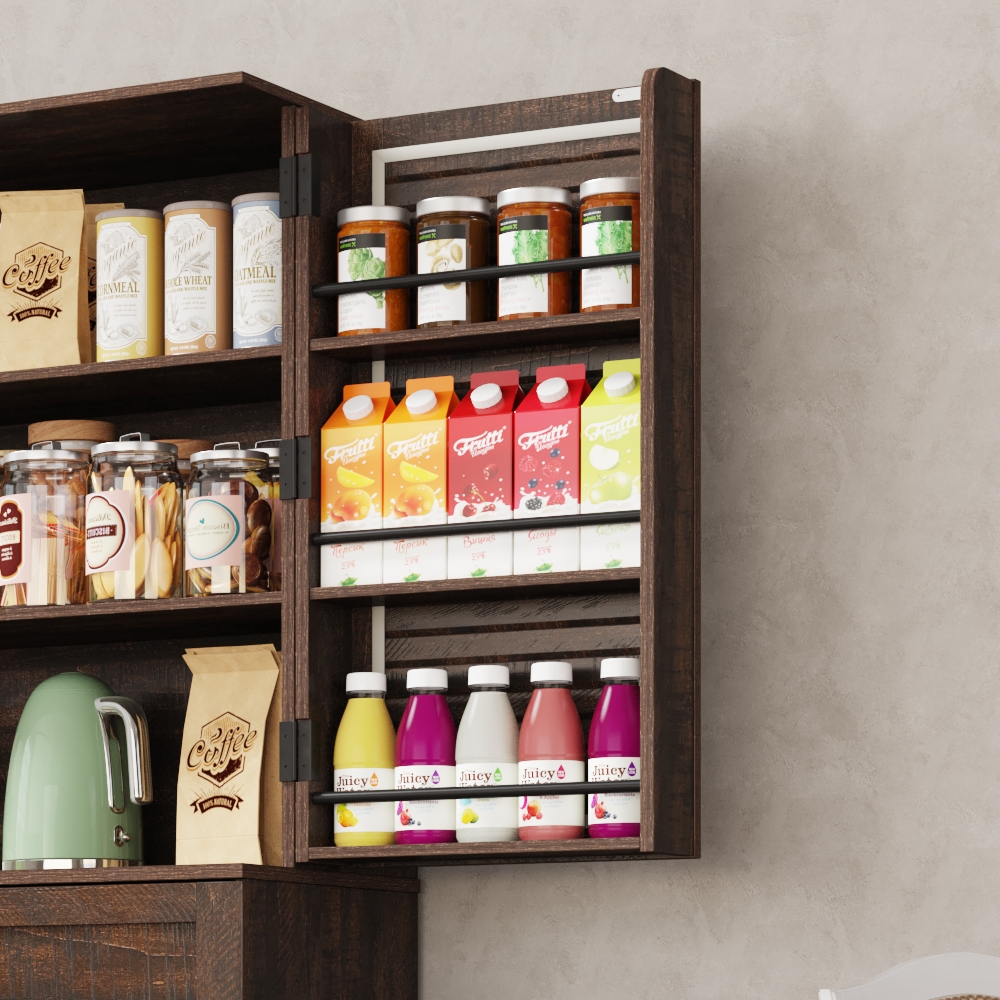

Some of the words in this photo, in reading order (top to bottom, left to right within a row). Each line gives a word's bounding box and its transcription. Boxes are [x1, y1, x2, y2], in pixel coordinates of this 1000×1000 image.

[2, 252, 72, 289] Coffee
[235, 265, 277, 282] OATMEAL
[184, 275, 213, 286] WHEAT
[584, 409, 640, 442] Frutti
[387, 427, 442, 459] Frutti
[453, 425, 507, 456] Frutti
[517, 420, 572, 450] Frutti
[324, 433, 379, 464] Frutti
[330, 542, 366, 558] Персик
[393, 537, 429, 554] Персик
[463, 534, 496, 549] Вишня
[186, 726, 257, 771] Coffee
[397, 772, 431, 786] Juicy
[459, 770, 493, 783] Juicy
[522, 767, 556, 780] Juicy
[592, 764, 627, 778] Juicy
[336, 775, 369, 788] Juicy
